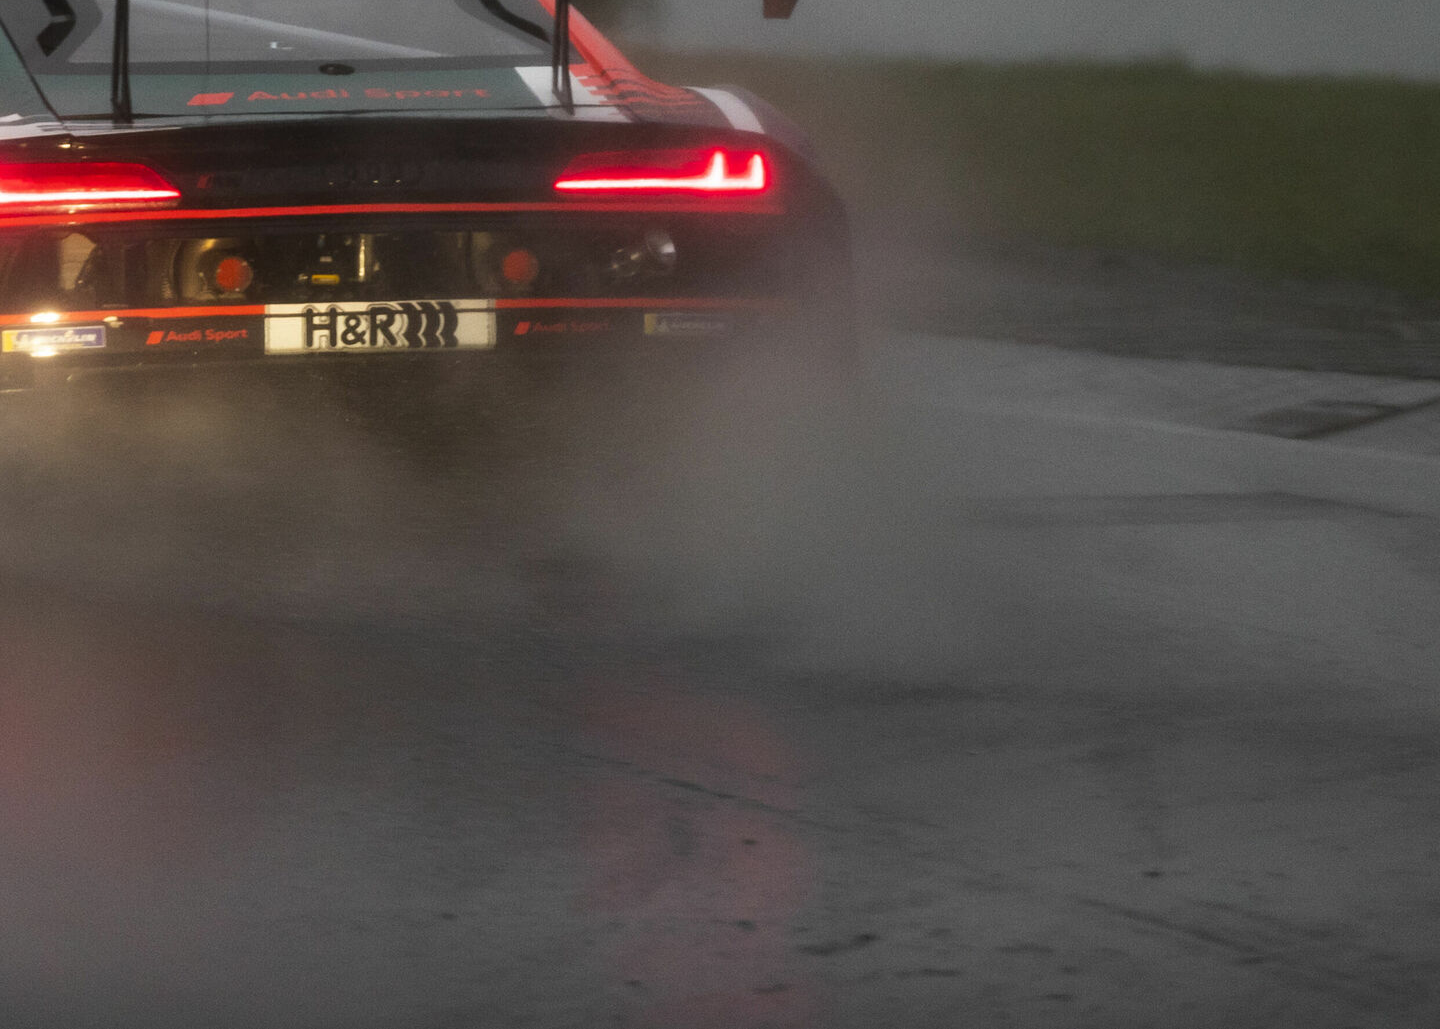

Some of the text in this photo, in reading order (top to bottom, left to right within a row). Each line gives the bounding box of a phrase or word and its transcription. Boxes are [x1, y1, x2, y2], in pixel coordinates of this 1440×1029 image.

[247, 87, 489, 101] Audi Sport
[304, 305, 400, 349] H&R
[165, 328, 249, 343] Audi Sport
